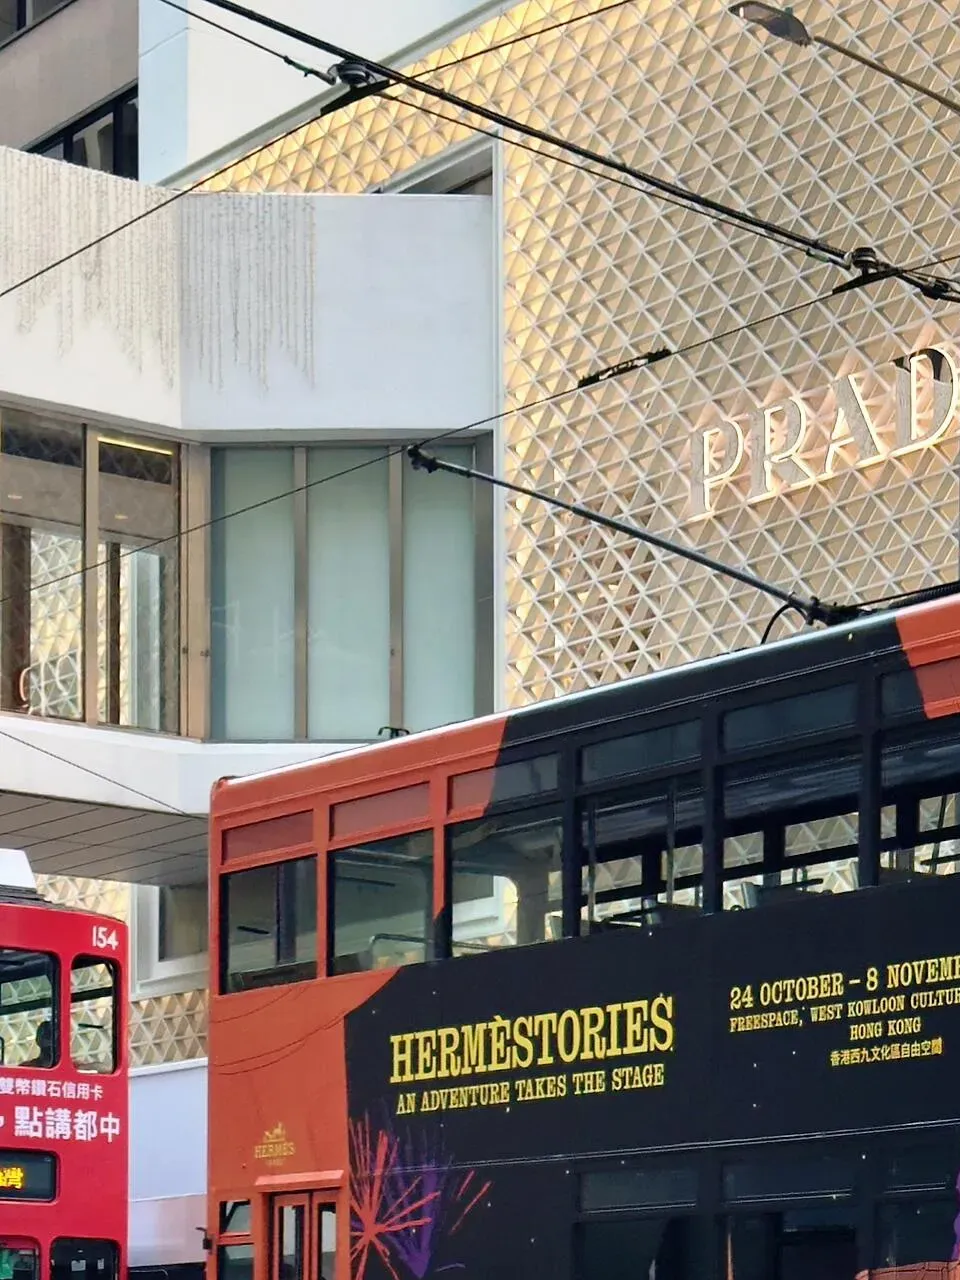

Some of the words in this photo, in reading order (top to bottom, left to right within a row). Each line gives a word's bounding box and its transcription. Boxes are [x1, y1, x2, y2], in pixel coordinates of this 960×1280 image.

[92, 925, 120, 951] 154
[730, 986, 753, 1011] 24
[759, 972, 845, 1006] OCTOBER
[865, 967, 879, 992] 8
[729, 1008, 803, 1033] FREESPACE,
[810, 1004, 843, 1024] WEST
[847, 997, 906, 1018] KOWLOON
[849, 1021, 882, 1041] HONG
[887, 1016, 922, 1036] KONG
[389, 993, 674, 1084] HERMÈSTORIES
[396, 1093, 416, 1115] AN
[420, 1082, 510, 1113] ADVENTURE
[515, 1074, 567, 1102] TAKES
[573, 1070, 605, 1095] THE
[612, 1063, 665, 1092] STAGE
